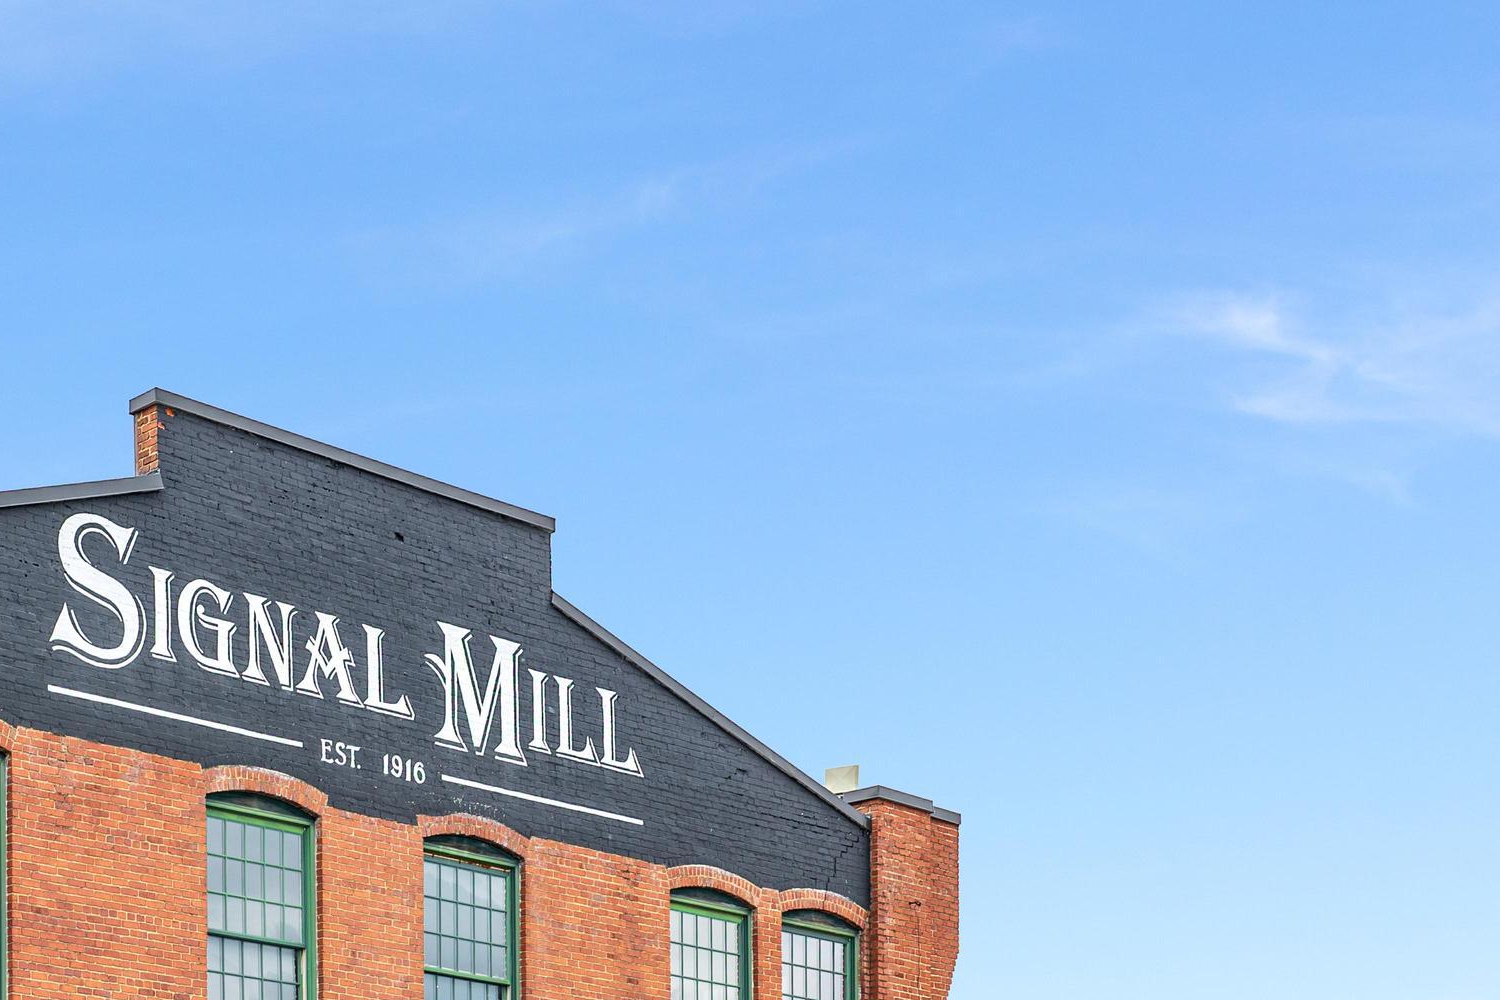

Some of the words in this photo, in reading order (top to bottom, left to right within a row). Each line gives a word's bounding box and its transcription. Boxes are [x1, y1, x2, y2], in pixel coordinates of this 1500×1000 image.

[50, 512, 414, 721] SIGNAL
[424, 620, 644, 778] MILL
[320, 739, 361, 770] EST.
[382, 754, 426, 785] 1916
